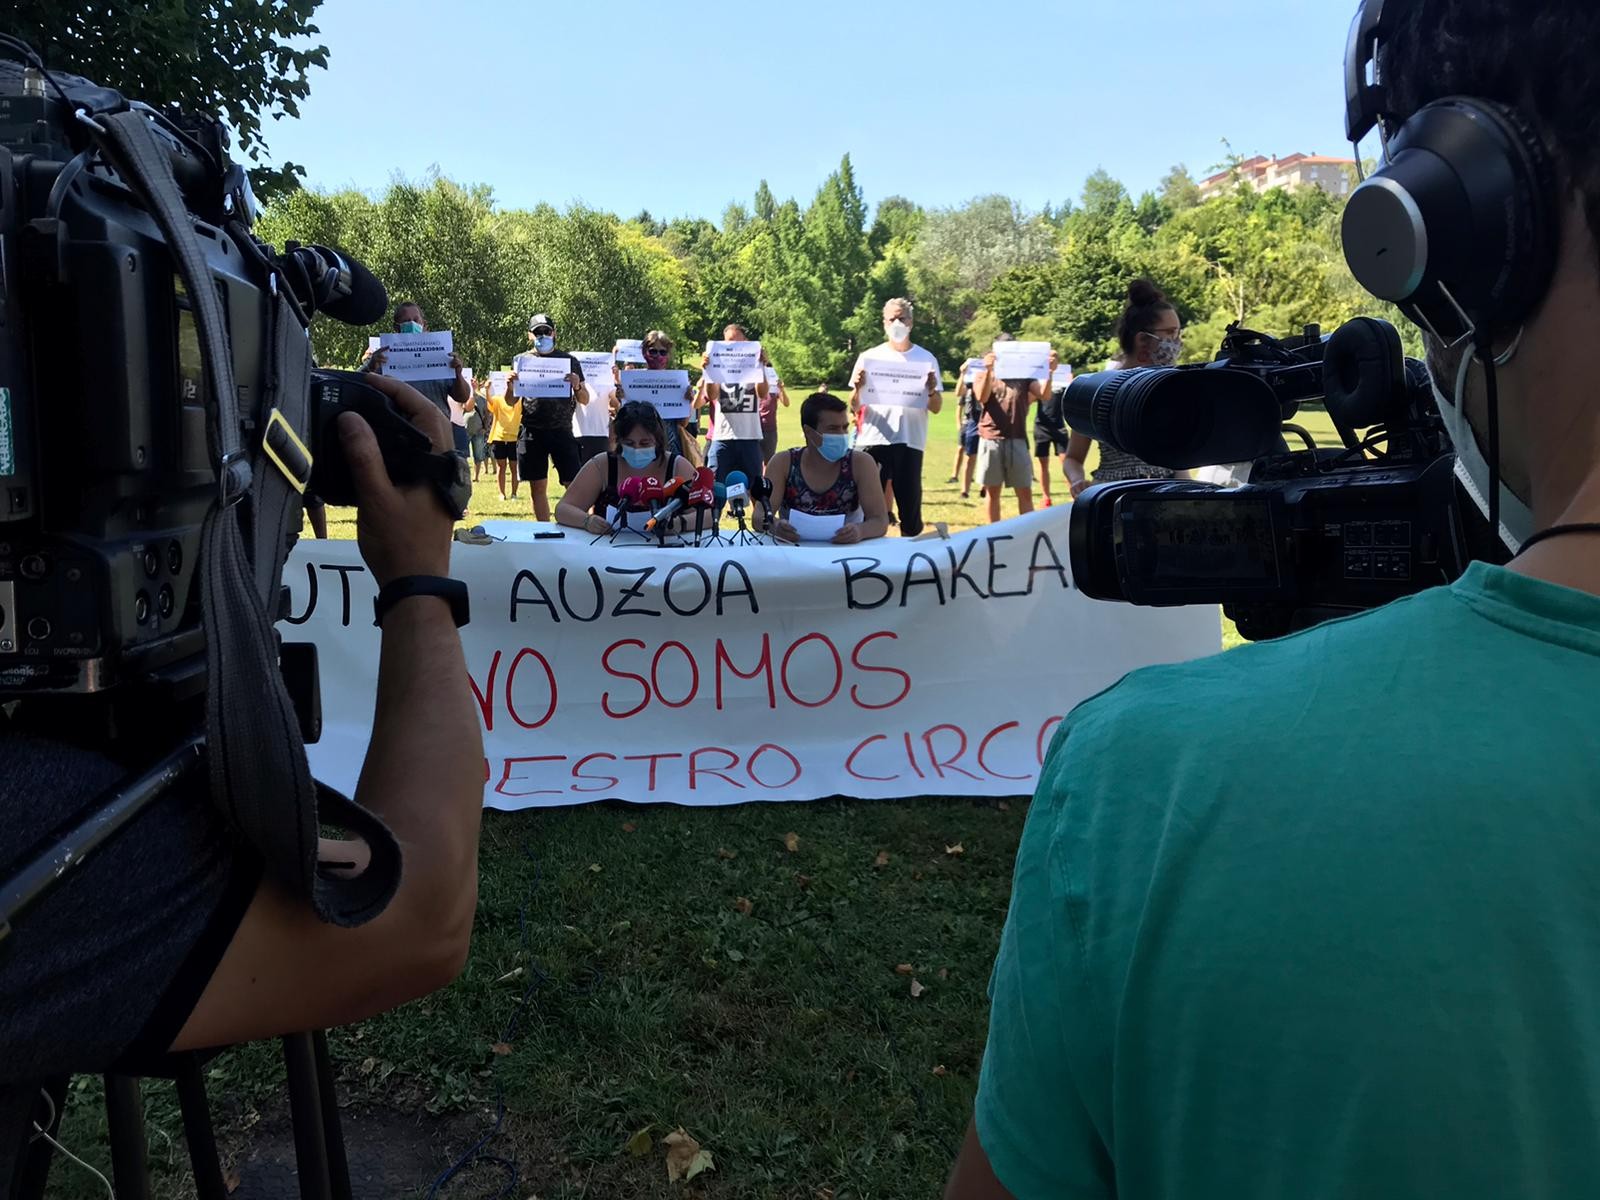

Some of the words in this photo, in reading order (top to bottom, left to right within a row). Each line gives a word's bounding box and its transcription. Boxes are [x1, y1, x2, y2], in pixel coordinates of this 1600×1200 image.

[510, 560, 759, 623] AUZOA
[832, 531, 1078, 609] BAKEA
[467, 647, 558, 731] NO
[601, 631, 911, 719] SOMOS
[484, 743, 802, 796] ESTRO
